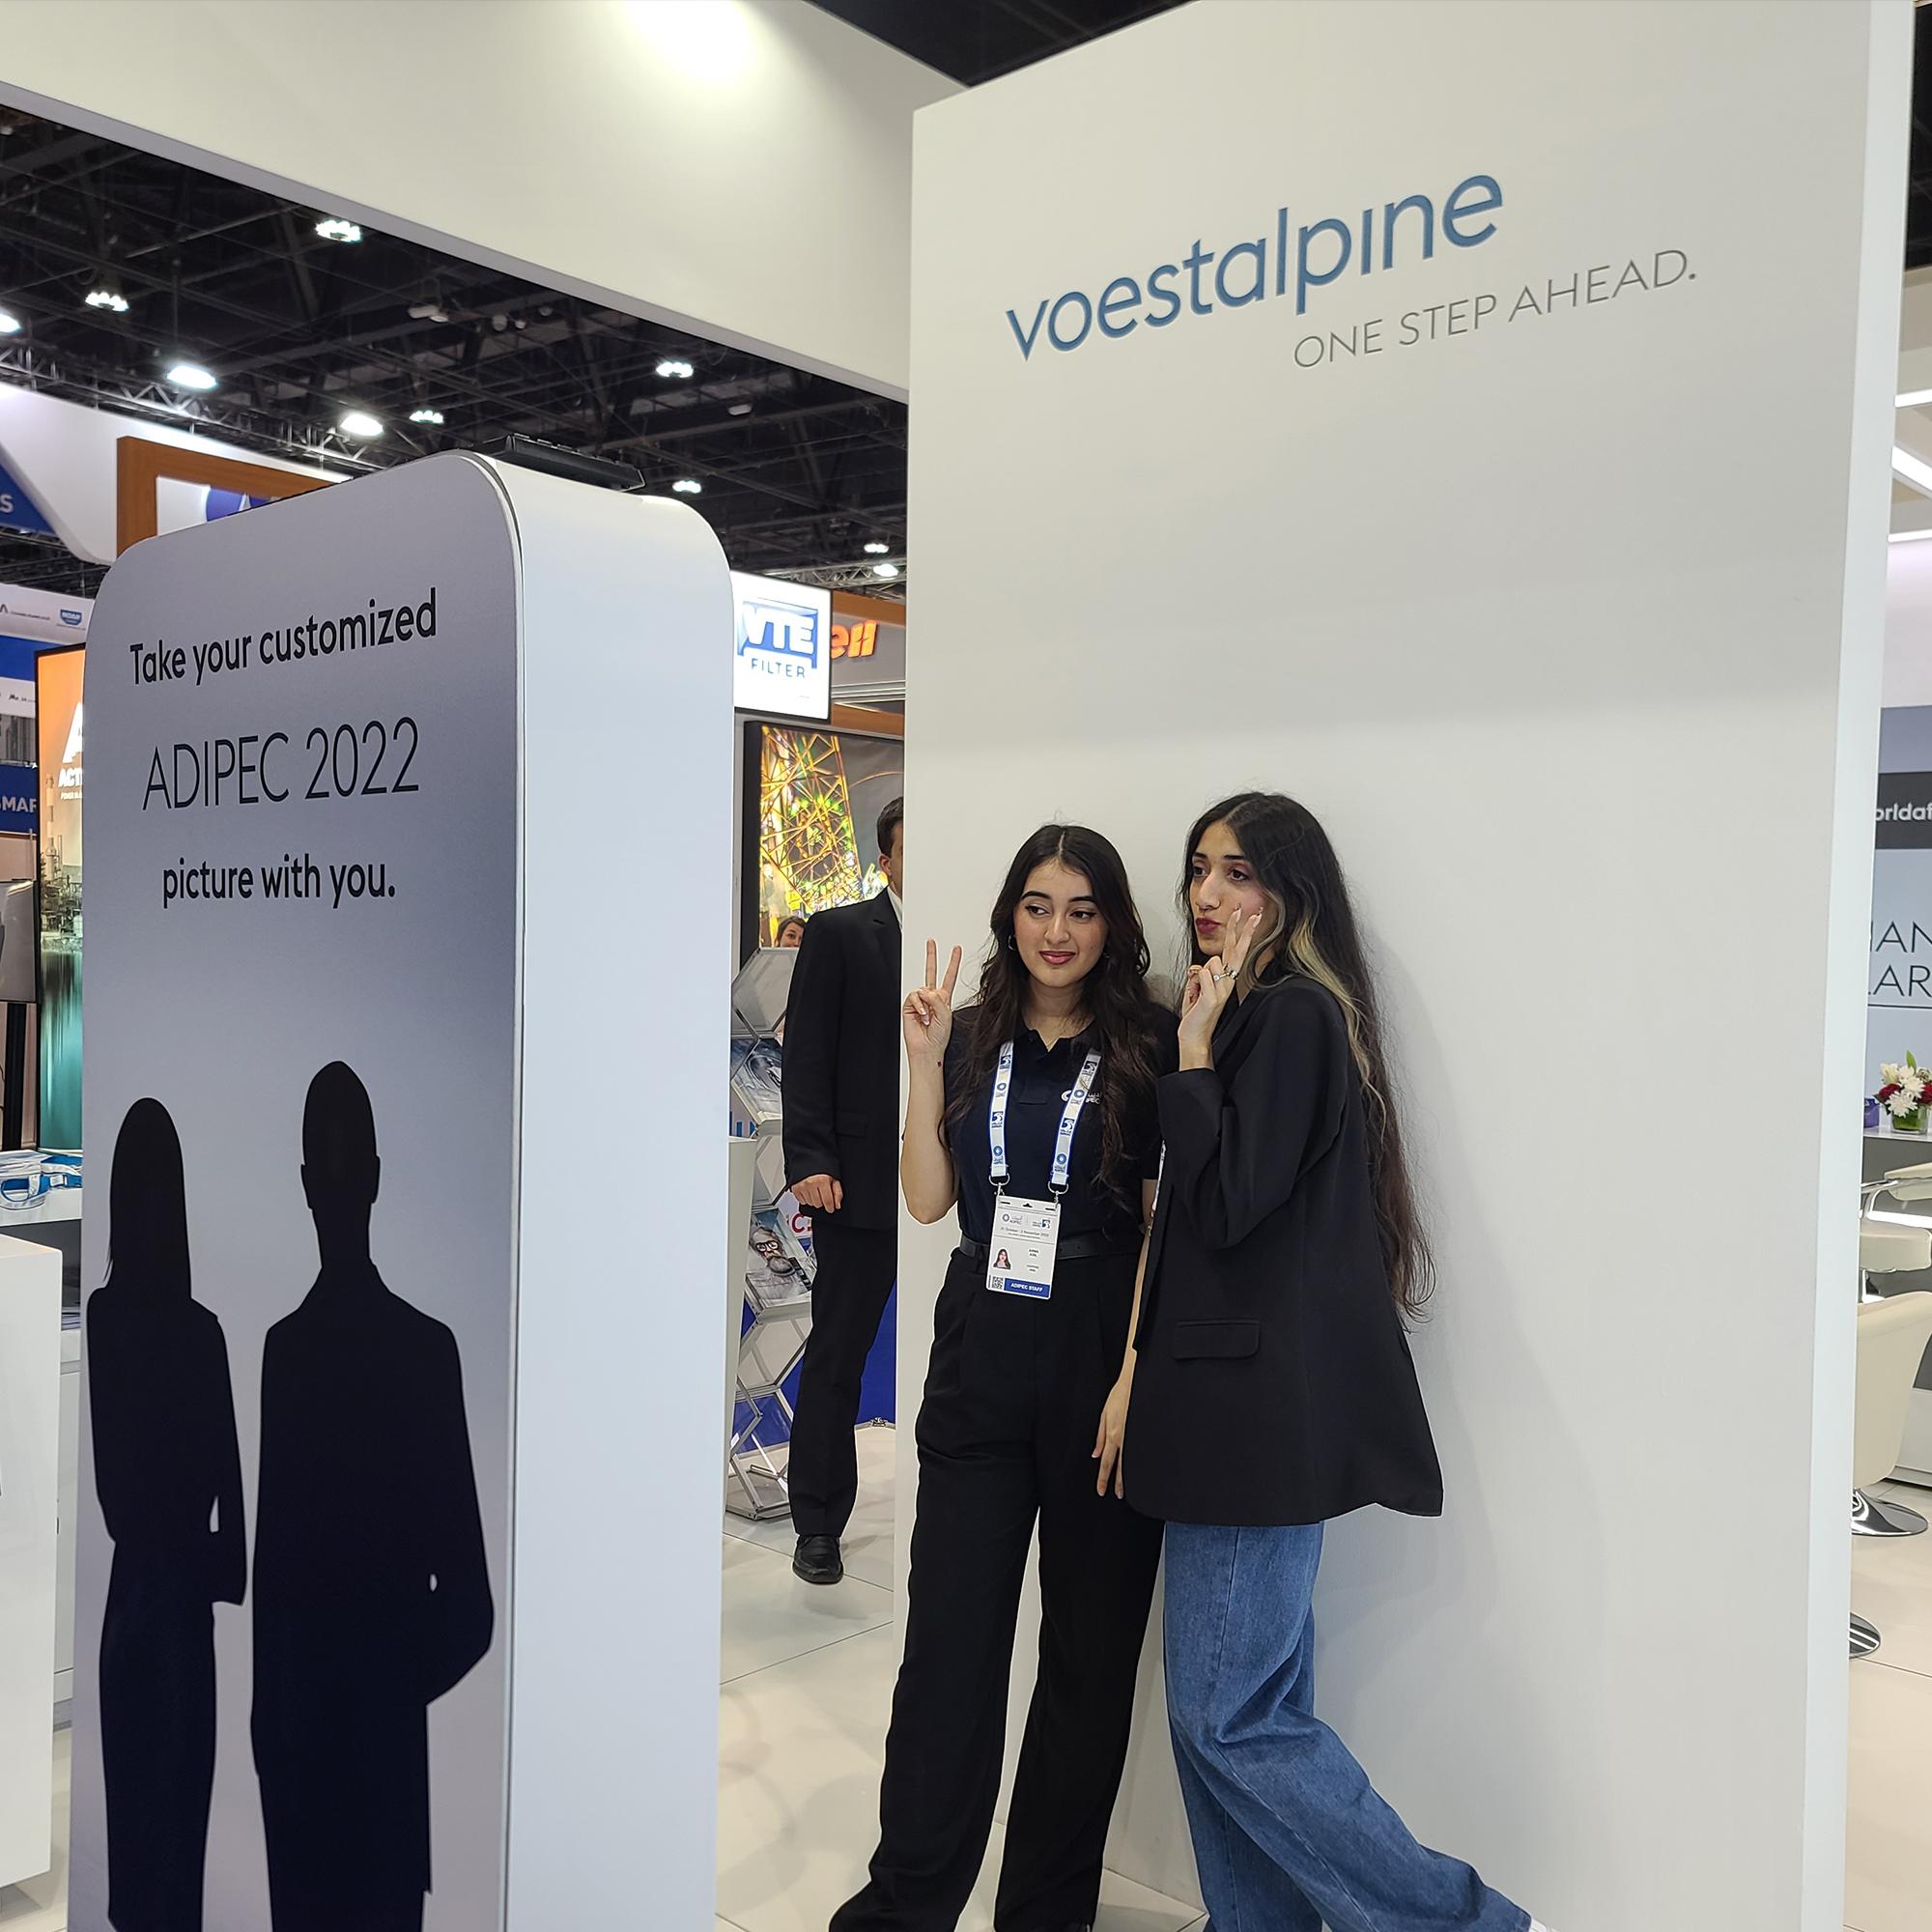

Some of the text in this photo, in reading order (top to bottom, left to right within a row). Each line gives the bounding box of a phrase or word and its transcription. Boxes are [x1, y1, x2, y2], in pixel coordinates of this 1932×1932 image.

[1006, 174, 1504, 362] voestalpine
[1293, 249, 1698, 369] ONE STEP AHEAD.
[129, 586, 437, 686] Take your customized
[751, 658, 806, 679] FILTER
[142, 717, 419, 811] ADIPEC 2022
[162, 853, 396, 909] picture with you.
